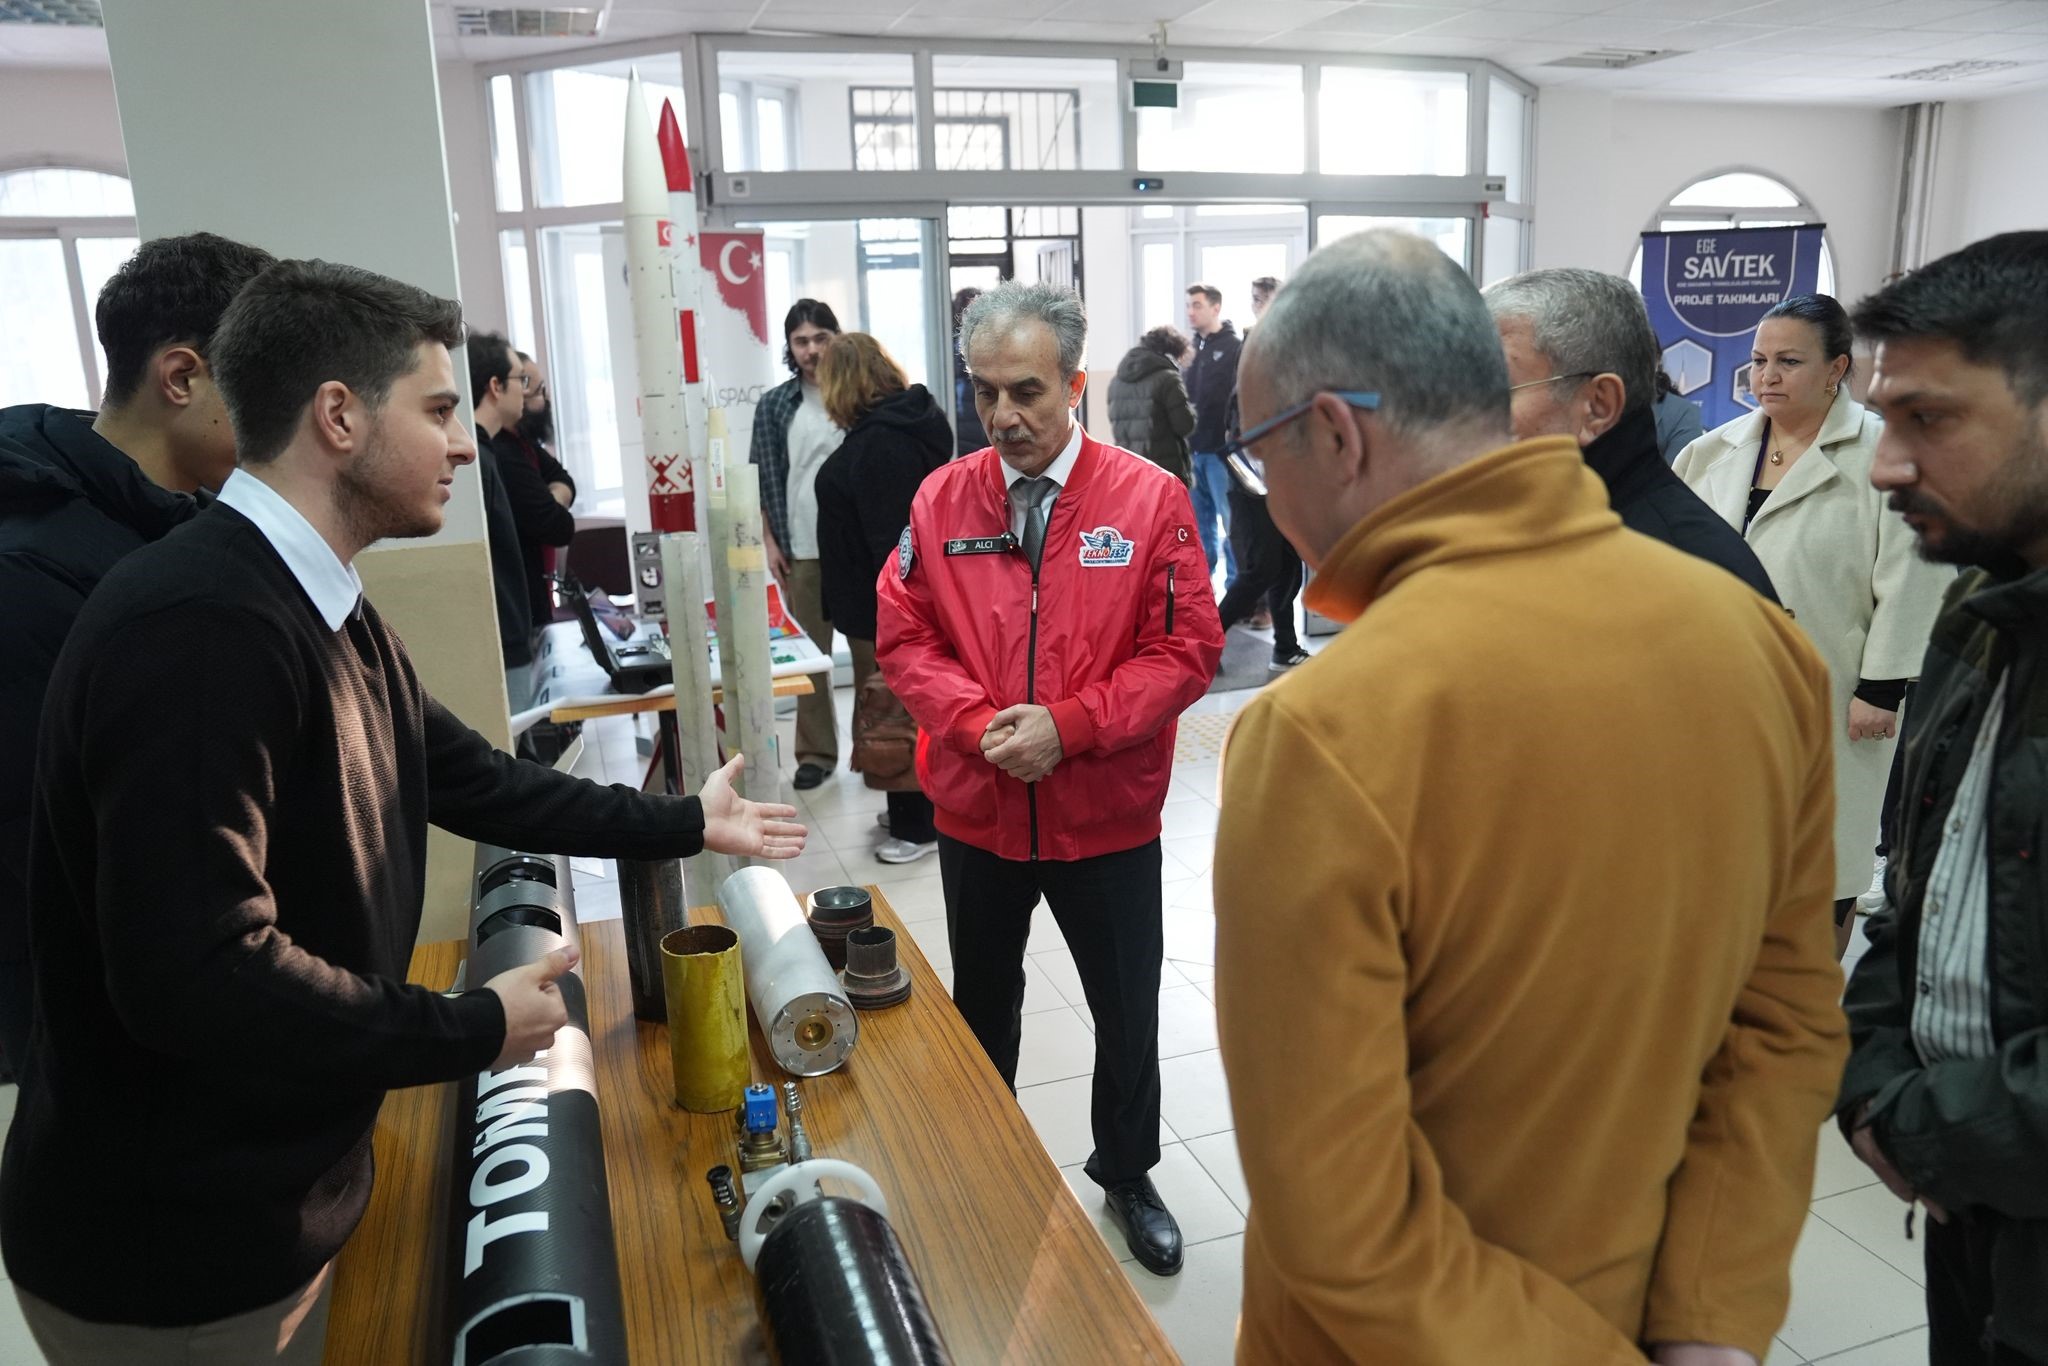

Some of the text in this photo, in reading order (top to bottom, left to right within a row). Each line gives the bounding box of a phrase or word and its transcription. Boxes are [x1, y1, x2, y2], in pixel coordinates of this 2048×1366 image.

[1696, 238, 1717, 254] EGE
[1684, 249, 1775, 279] SAVTEK
[1674, 292, 1780, 306] PROJE TAKIMLARI
[975, 541, 993, 549] ALCI
[1083, 547, 1131, 559] TEKNOFEST
